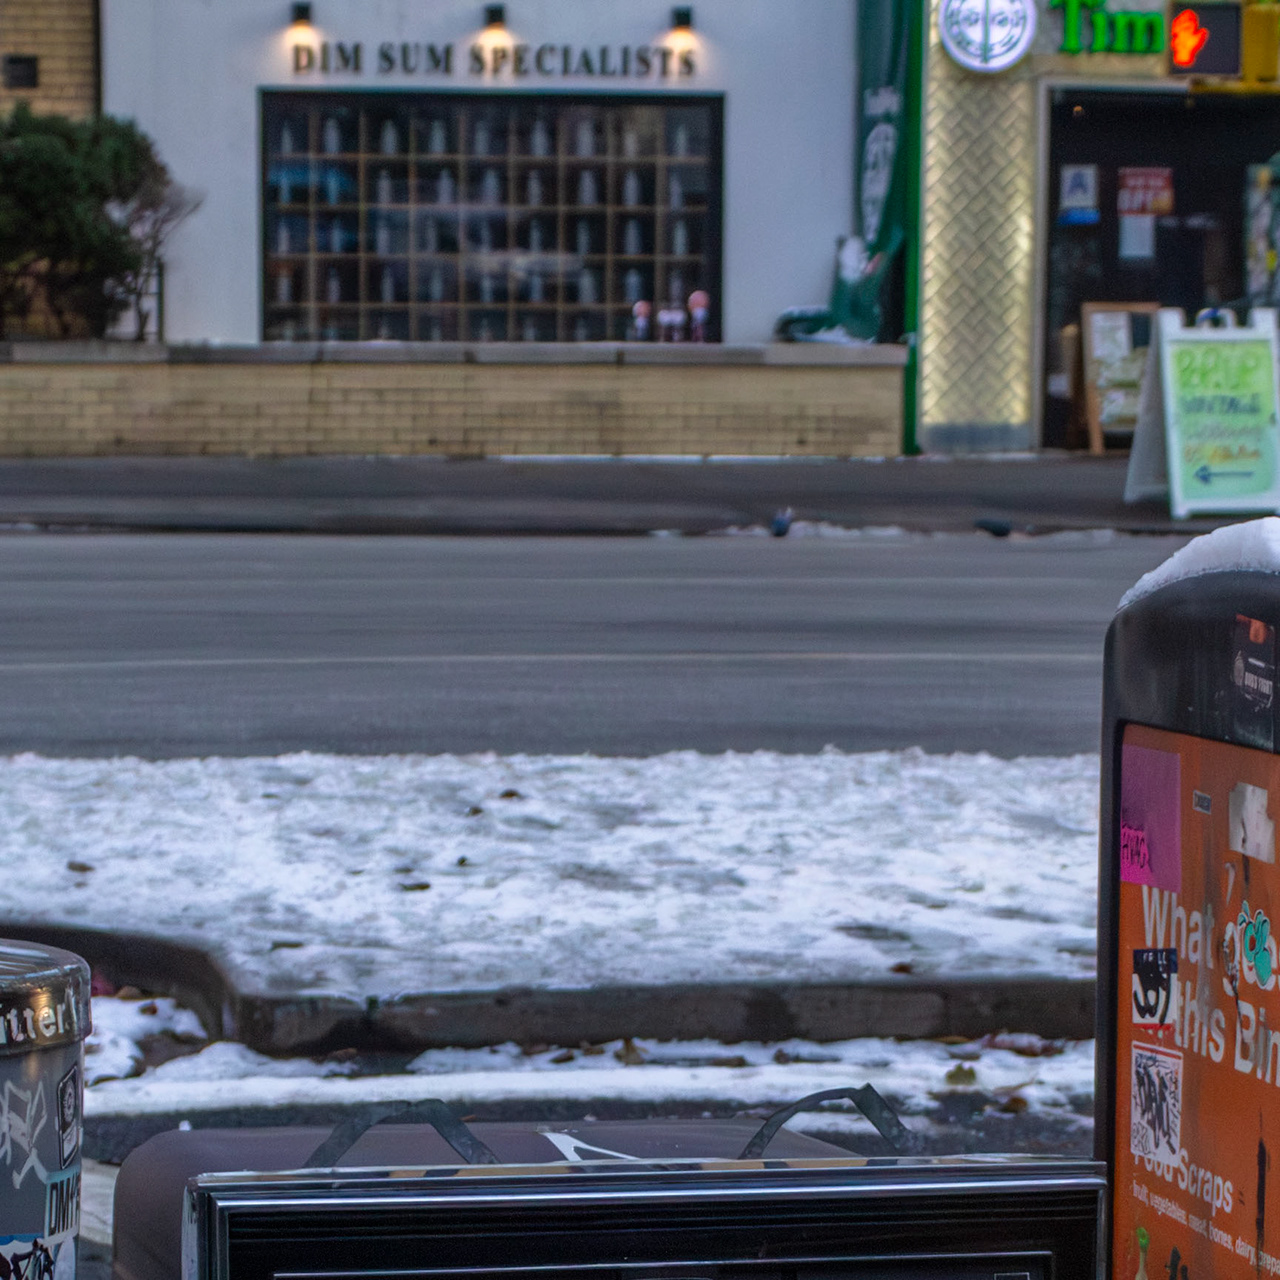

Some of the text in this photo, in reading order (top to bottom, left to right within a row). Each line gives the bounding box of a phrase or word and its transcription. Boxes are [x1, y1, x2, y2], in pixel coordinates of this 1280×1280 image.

[293, 42, 695, 78] DIM SUM SPECIALISTS
[1051, 0, 1164, 54] Tim
[1142, 884, 1214, 970] What
[1175, 979, 1227, 1064] this
[1176, 1147, 1234, 1217] Scraps
